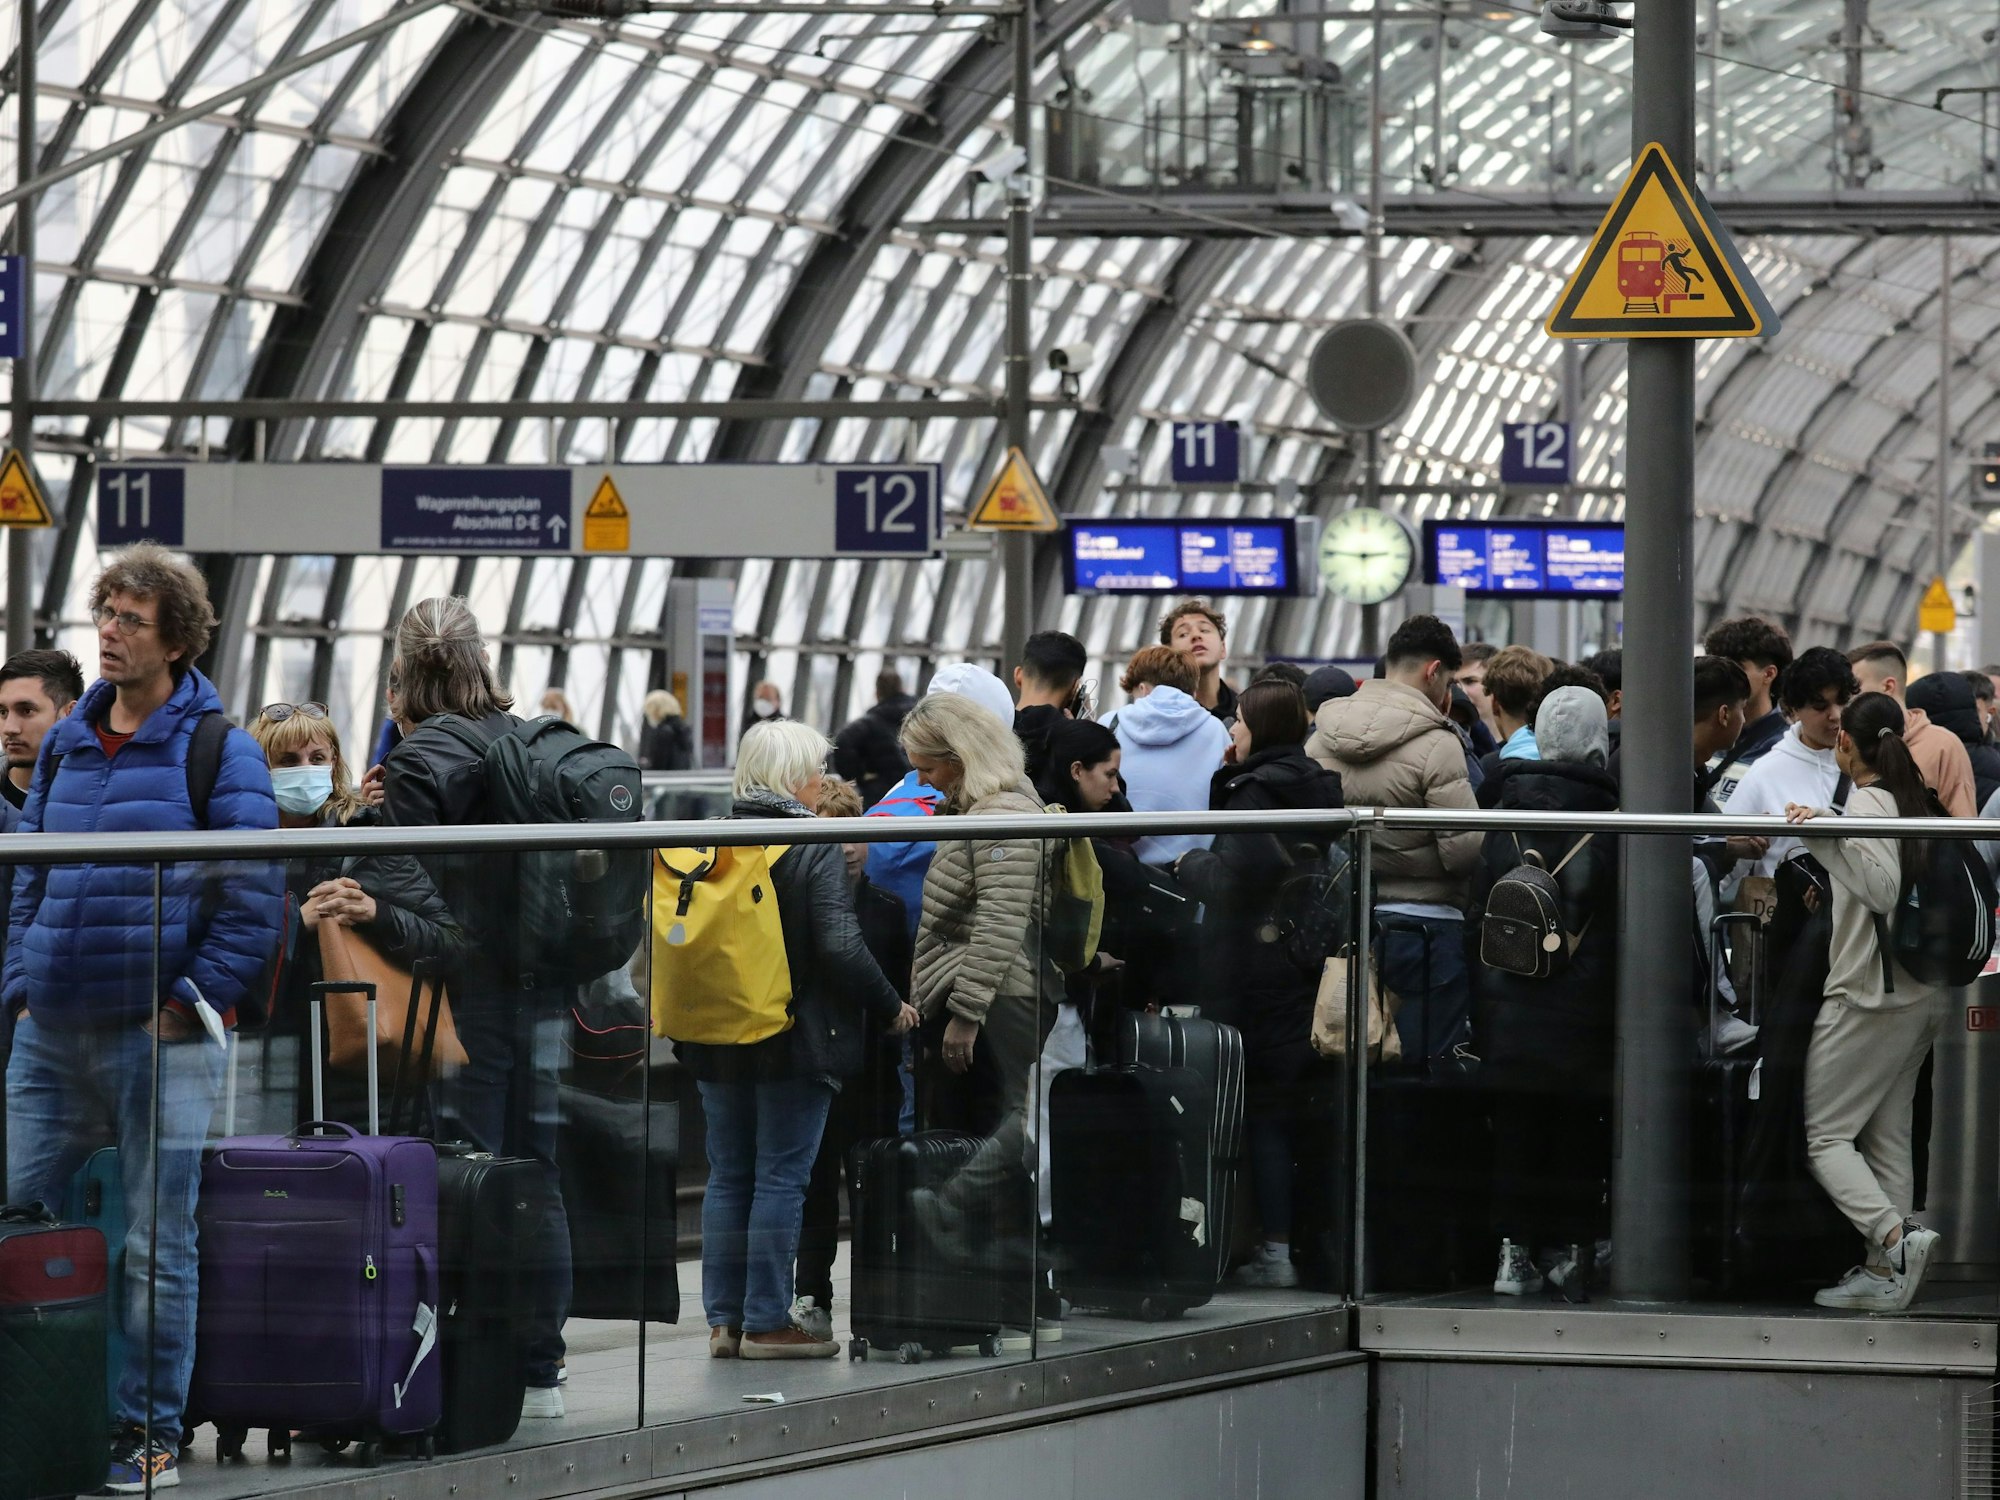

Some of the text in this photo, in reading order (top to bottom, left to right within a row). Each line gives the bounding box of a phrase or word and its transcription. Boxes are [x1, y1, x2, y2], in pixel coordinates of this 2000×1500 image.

[1176, 424, 1216, 467] 11
[1514, 424, 1565, 469] 12
[107, 471, 150, 528] 11
[416, 495, 541, 513] Wagenreihungsplan
[854, 474, 916, 533] 12
[452, 514, 541, 531] Abschnitt D-E
